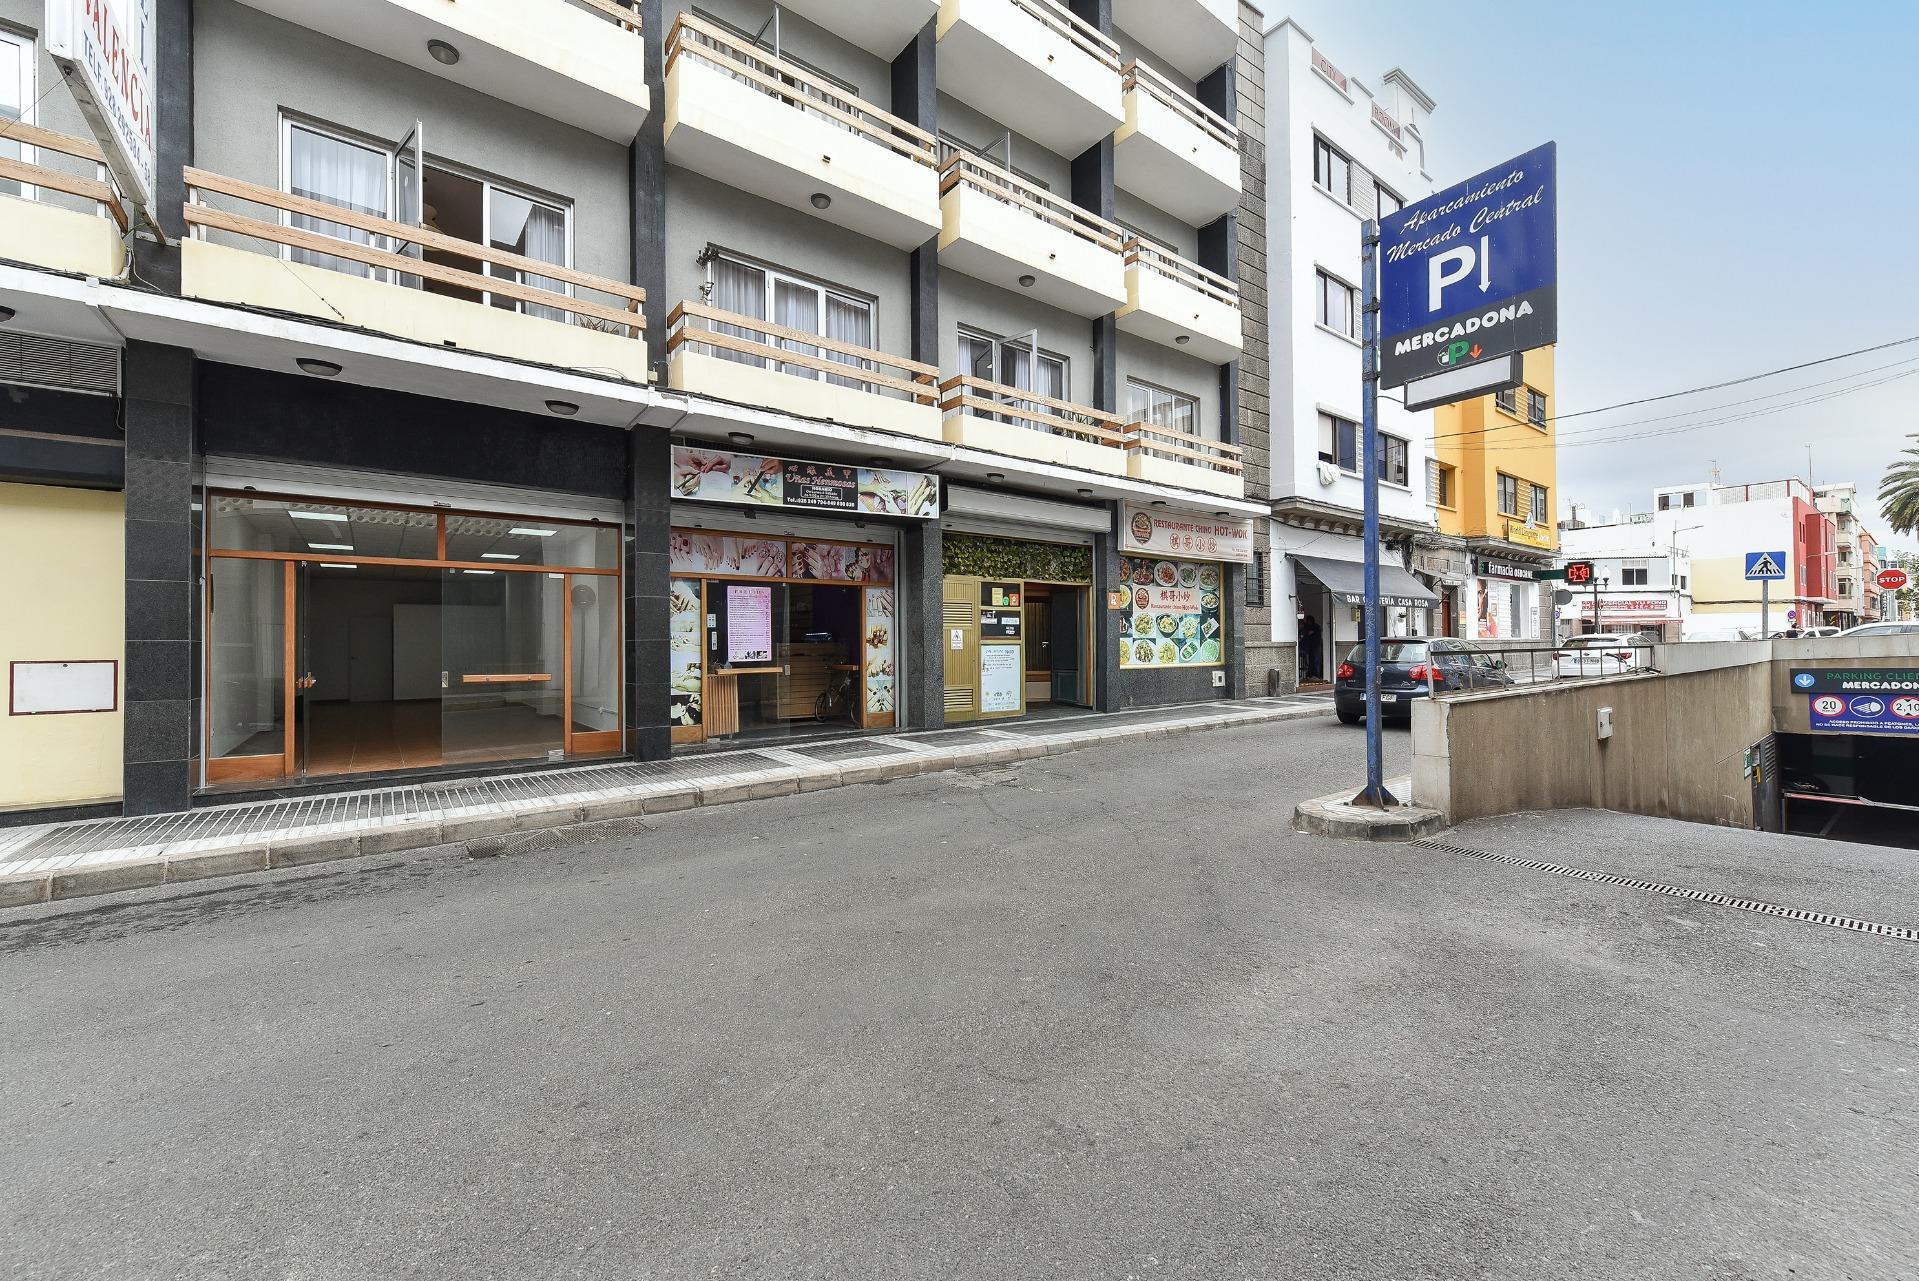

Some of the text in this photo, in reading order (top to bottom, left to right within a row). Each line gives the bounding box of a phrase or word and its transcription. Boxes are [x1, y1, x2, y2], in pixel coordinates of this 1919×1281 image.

[86, 0, 151, 153] ALENCIA
[1399, 169, 1524, 235] Aparcamiento
[1386, 184, 1544, 264] Mercado Central
[1428, 245, 1476, 313] P
[1394, 300, 1534, 357] MERCADONA
[1153, 519, 1194, 533] RESTAURANTE
[1195, 524, 1212, 534] CHINO
[1488, 560, 1514, 577] farmacia
[1878, 576, 1906, 584] STOP
[1346, 594, 1361, 604] BAR
[1397, 597, 1413, 607] CASA
[1414, 598, 1429, 608] ROSA
[1826, 672, 1883, 681] PARKING
[1821, 700, 1837, 710] 20
